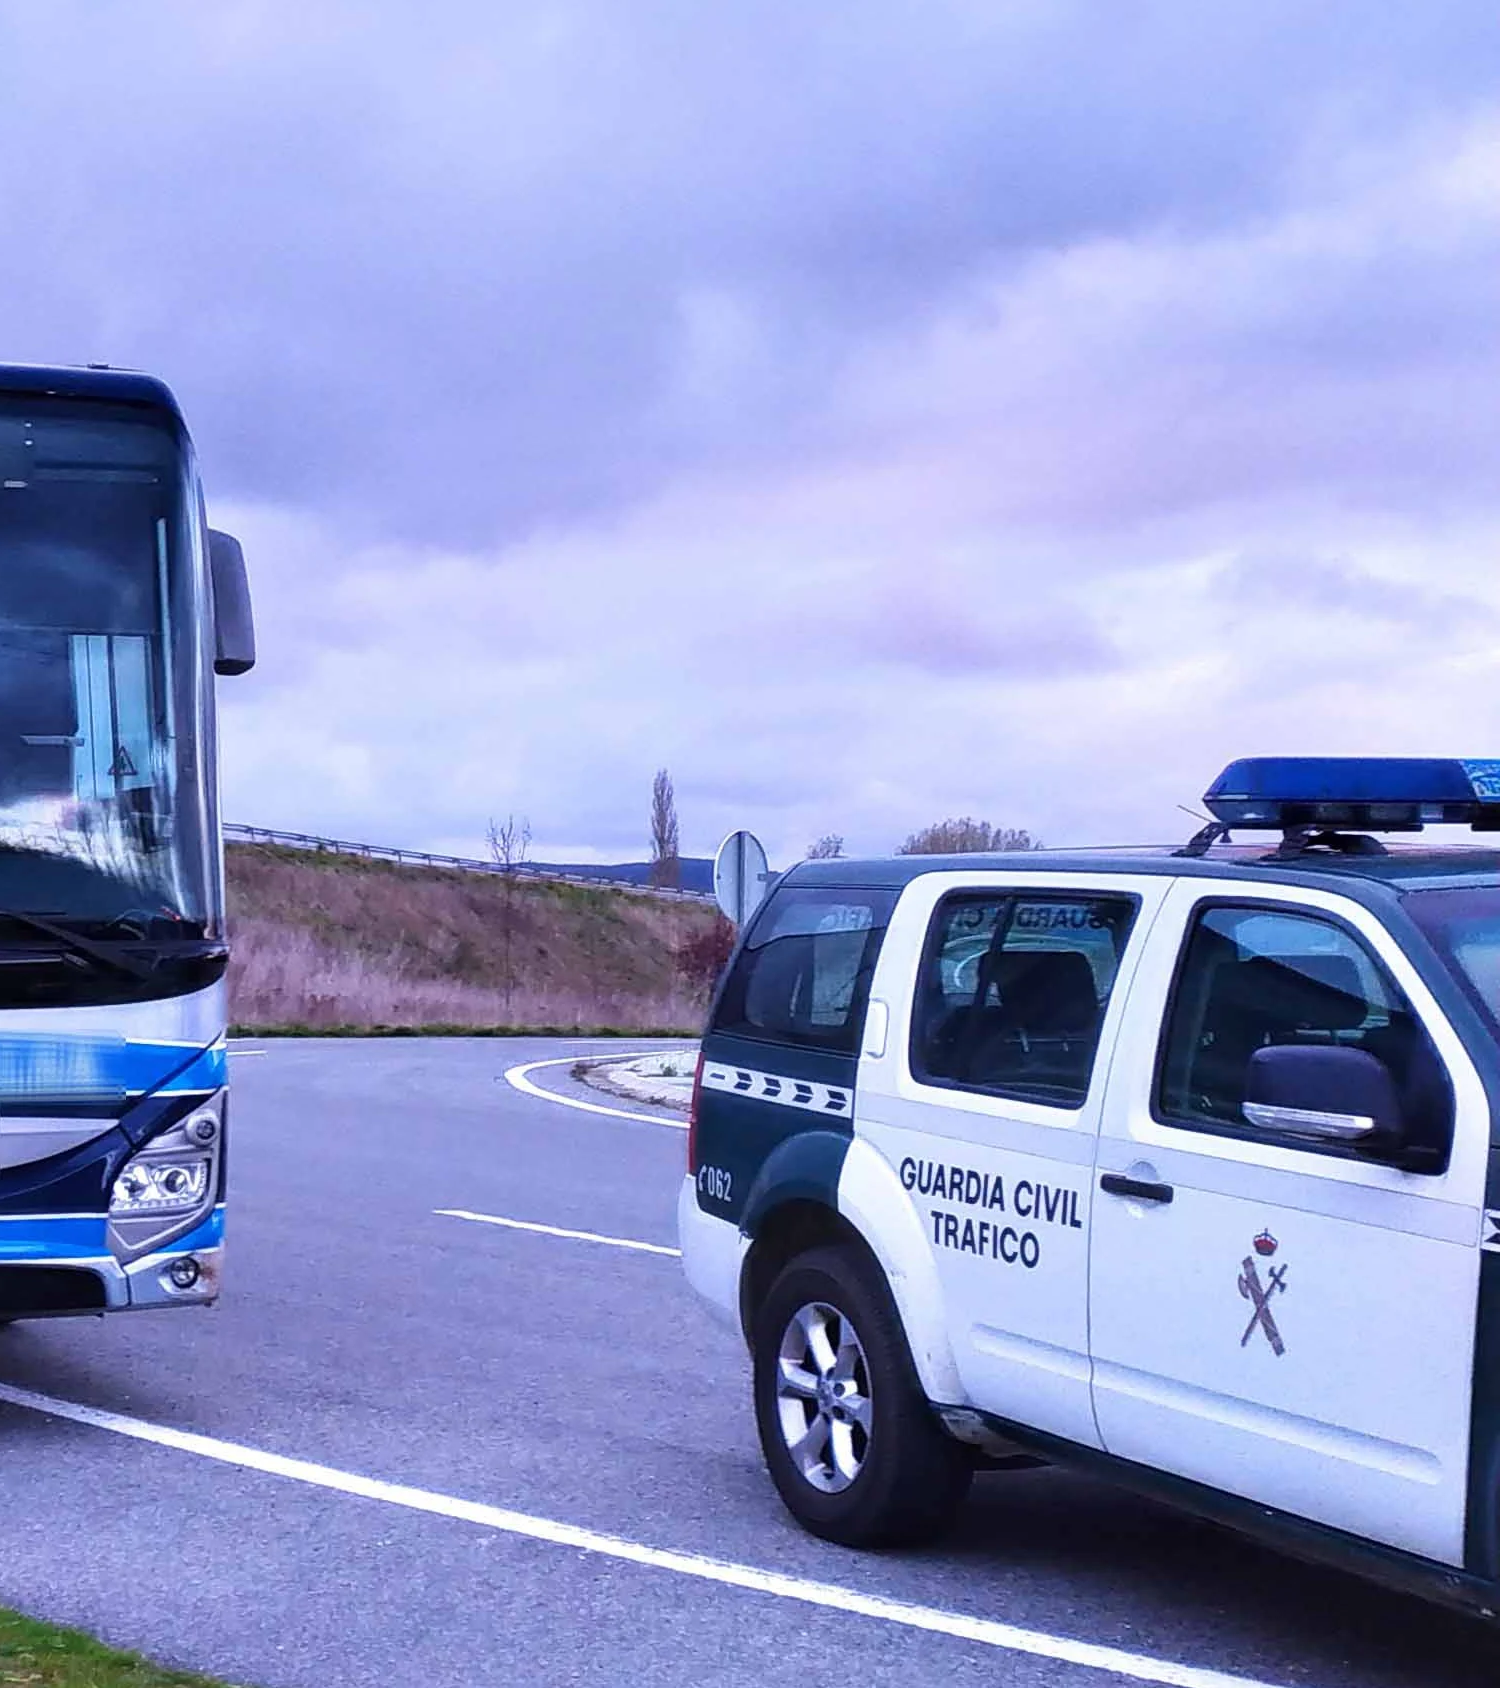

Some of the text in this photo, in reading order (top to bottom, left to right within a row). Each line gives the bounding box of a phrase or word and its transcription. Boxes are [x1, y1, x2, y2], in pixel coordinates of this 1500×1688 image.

[707, 1166, 732, 1202] 062
[900, 1157, 1083, 1229] GUARDIA CIVIL
[930, 1210, 1040, 1269] TRAFICO
